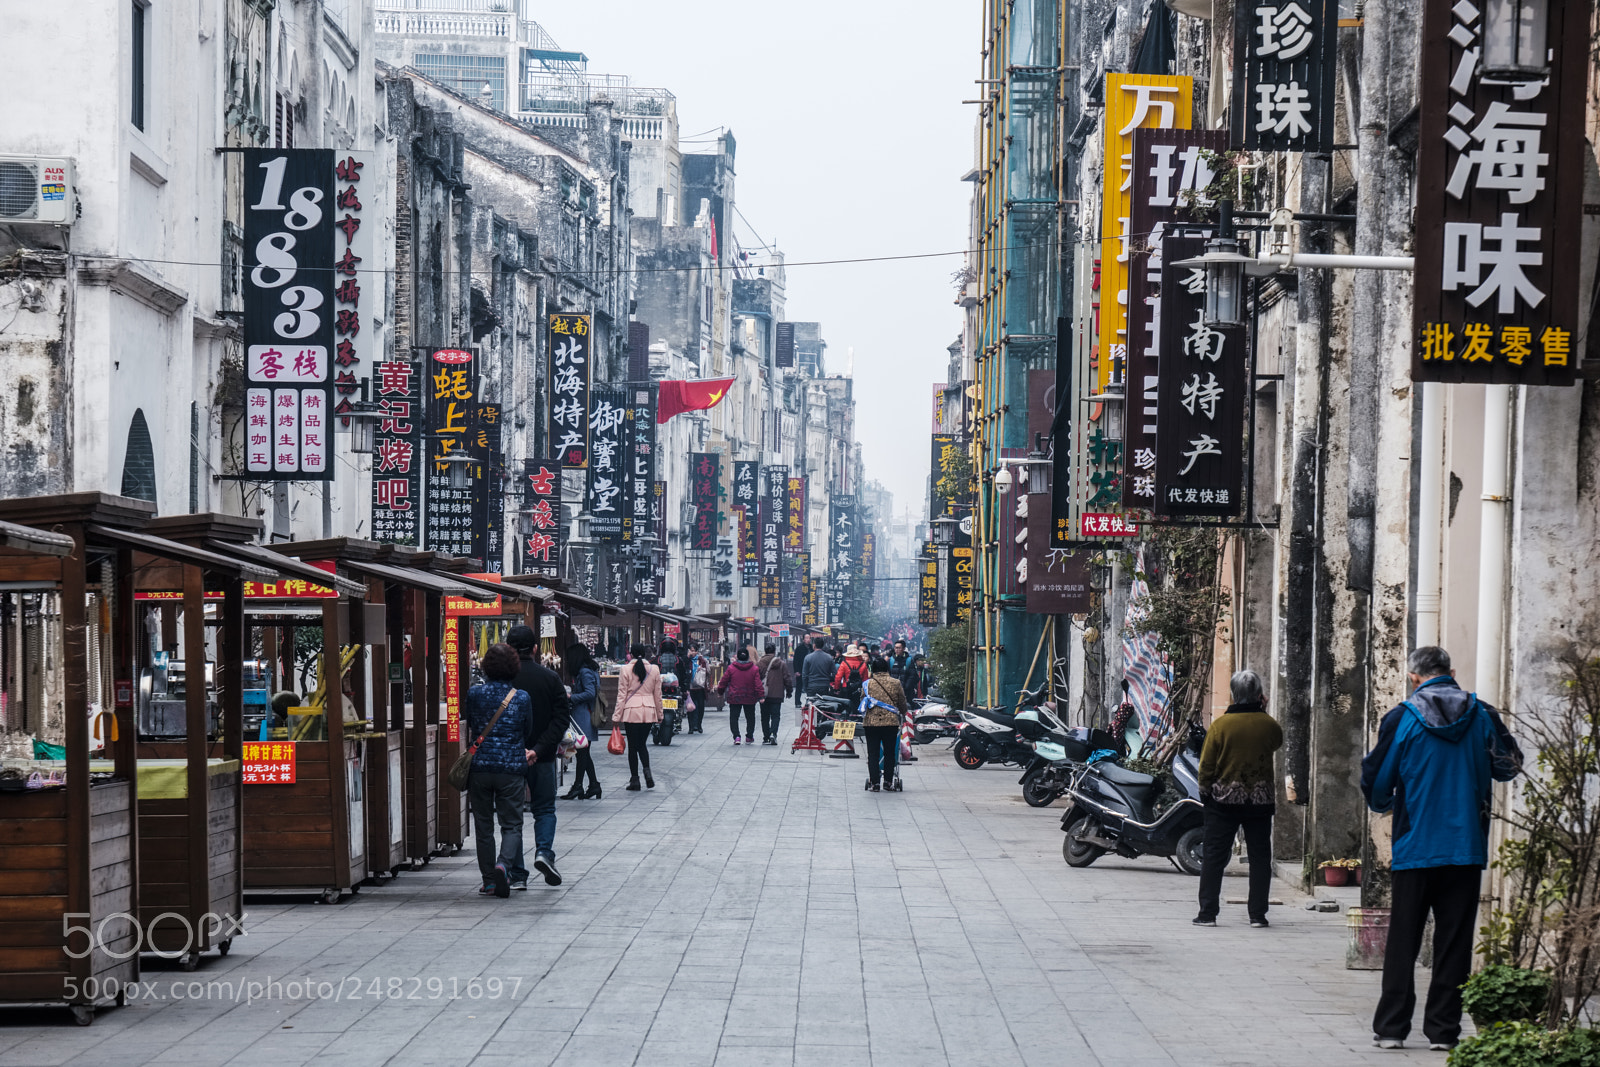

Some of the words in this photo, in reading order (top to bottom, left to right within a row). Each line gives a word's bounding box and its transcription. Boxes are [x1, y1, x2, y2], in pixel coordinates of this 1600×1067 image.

[1256, 2, 1313, 139] 珍珠
[250, 156, 325, 339] 1883
[551, 318, 588, 336] 越南
[1422, 322, 1572, 366] 批发零售
[255, 348, 320, 379] 客栈
[436, 352, 469, 361] 老字号
[553, 336, 585, 460] 北海特产
[250, 394, 268, 465] 海鲜咖王
[277, 395, 295, 465] 爆烤生蚝
[304, 395, 322, 466] 精品民宿
[377, 361, 413, 510] 黄记烤吧
[429, 490, 472, 500] 海鲜加工
[694, 456, 716, 549] 南流江玉石
[1168, 488, 1230, 504] 代发快递
[375, 510, 414, 520] 特色小吃
[429, 503, 472, 513] 海鲜烧烤
[375, 520, 414, 529] 各式小炒
[429, 517, 472, 527] 海鲜小炒
[1084, 516, 1137, 534] 代发快递
[429, 531, 472, 541] 烧腊套餐
[429, 544, 472, 554] 农夫果园
[446, 618, 458, 664] 黄金鱼蛋
